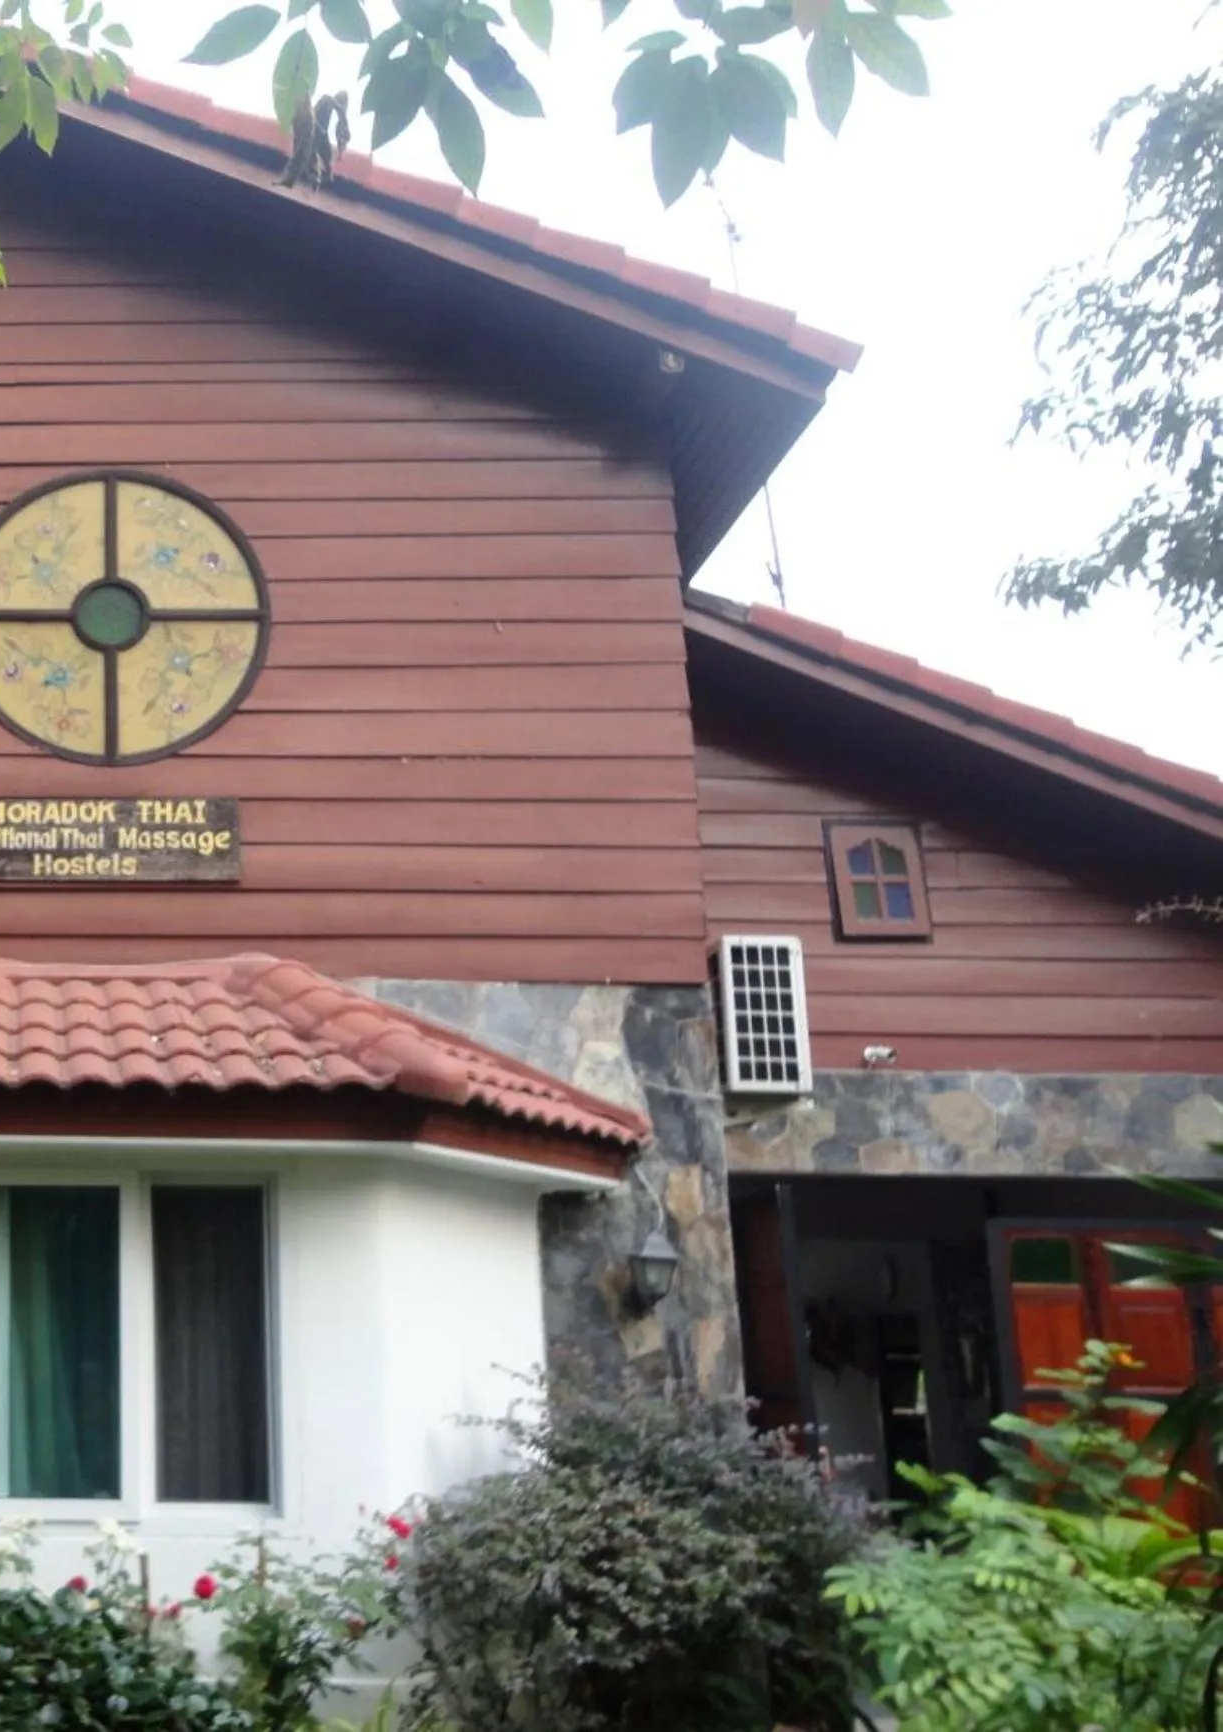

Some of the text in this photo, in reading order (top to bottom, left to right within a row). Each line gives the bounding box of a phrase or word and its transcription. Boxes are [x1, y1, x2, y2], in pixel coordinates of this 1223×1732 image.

[137, 799, 207, 824] THAI
[61, 826, 105, 849] Thai
[118, 826, 232, 856] Massage
[34, 853, 137, 876] Hostels
